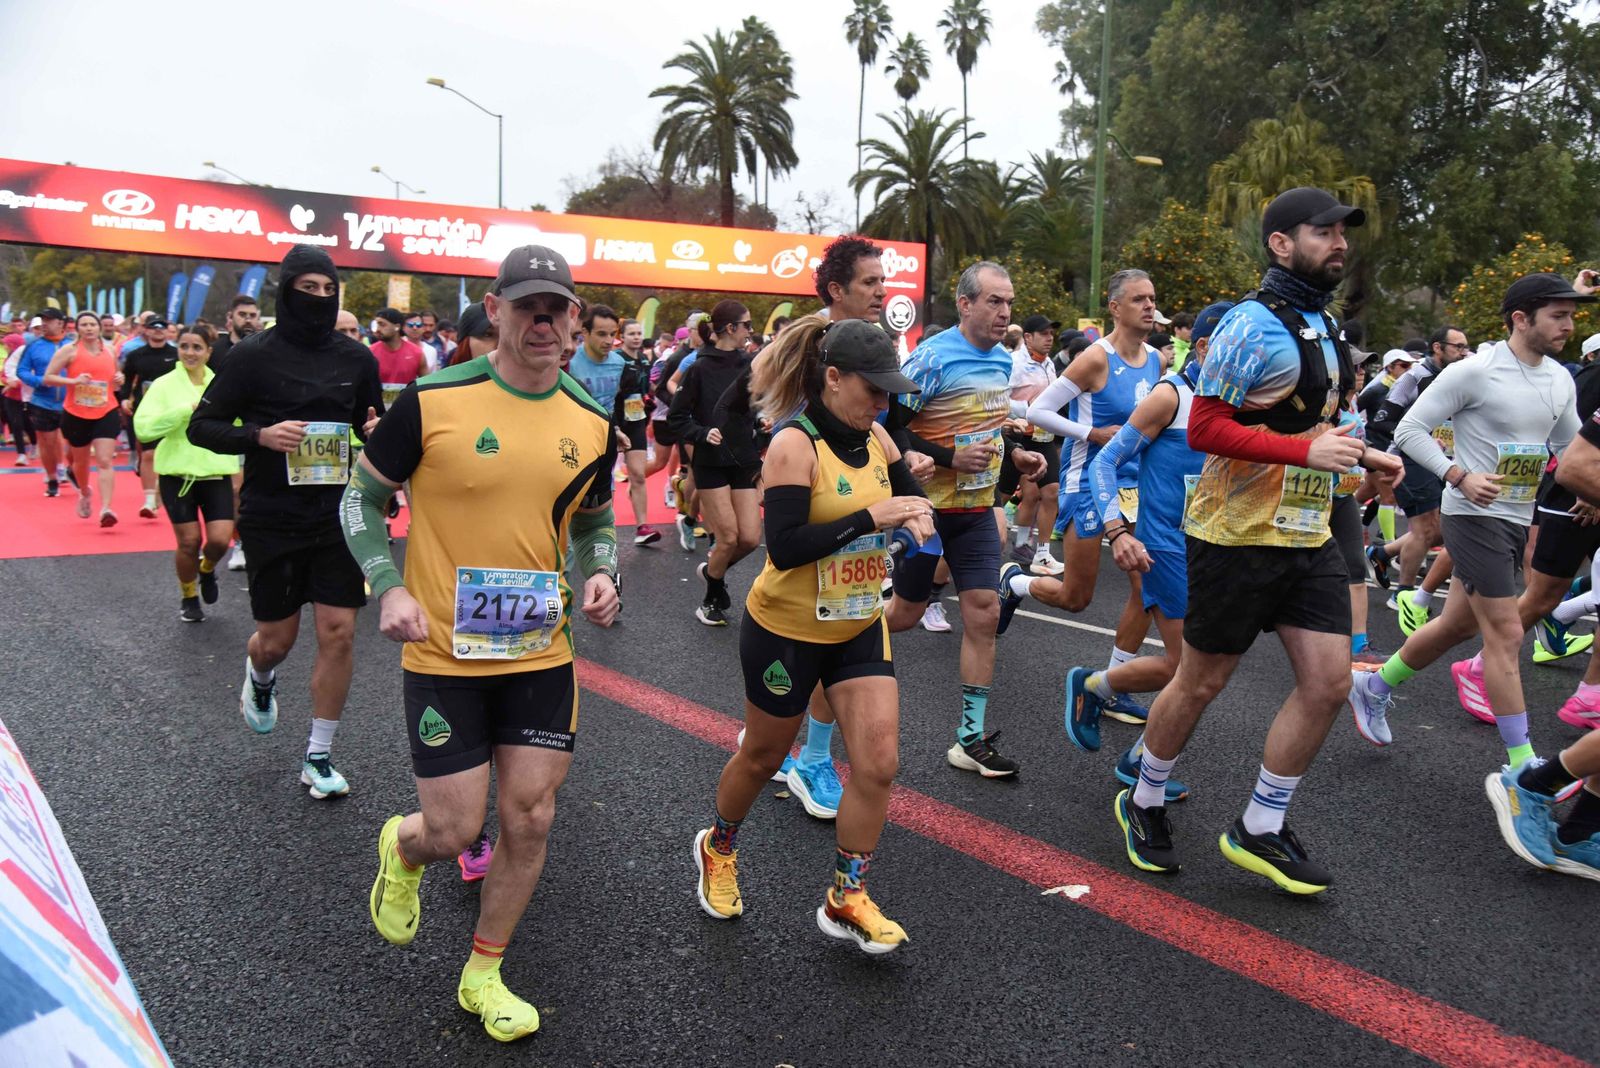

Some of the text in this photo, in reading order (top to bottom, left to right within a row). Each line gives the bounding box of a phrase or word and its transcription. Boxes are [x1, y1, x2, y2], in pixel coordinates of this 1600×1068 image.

[174, 203, 264, 236] HOKA
[373, 214, 482, 241] maratón
[402, 235, 482, 258] sevilla
[593, 238, 656, 263] HOKA
[1503, 457, 1542, 477] 12640
[1292, 472, 1329, 499] 1122
[495, 571, 529, 580] maratón
[502, 578, 530, 586] sevilla
[826, 555, 887, 586] 15869
[471, 591, 539, 621] 2172
[420, 719, 447, 737] Jaén
[538, 730, 572, 741] HYUNDAI
[529, 737, 566, 748] JACARSA
